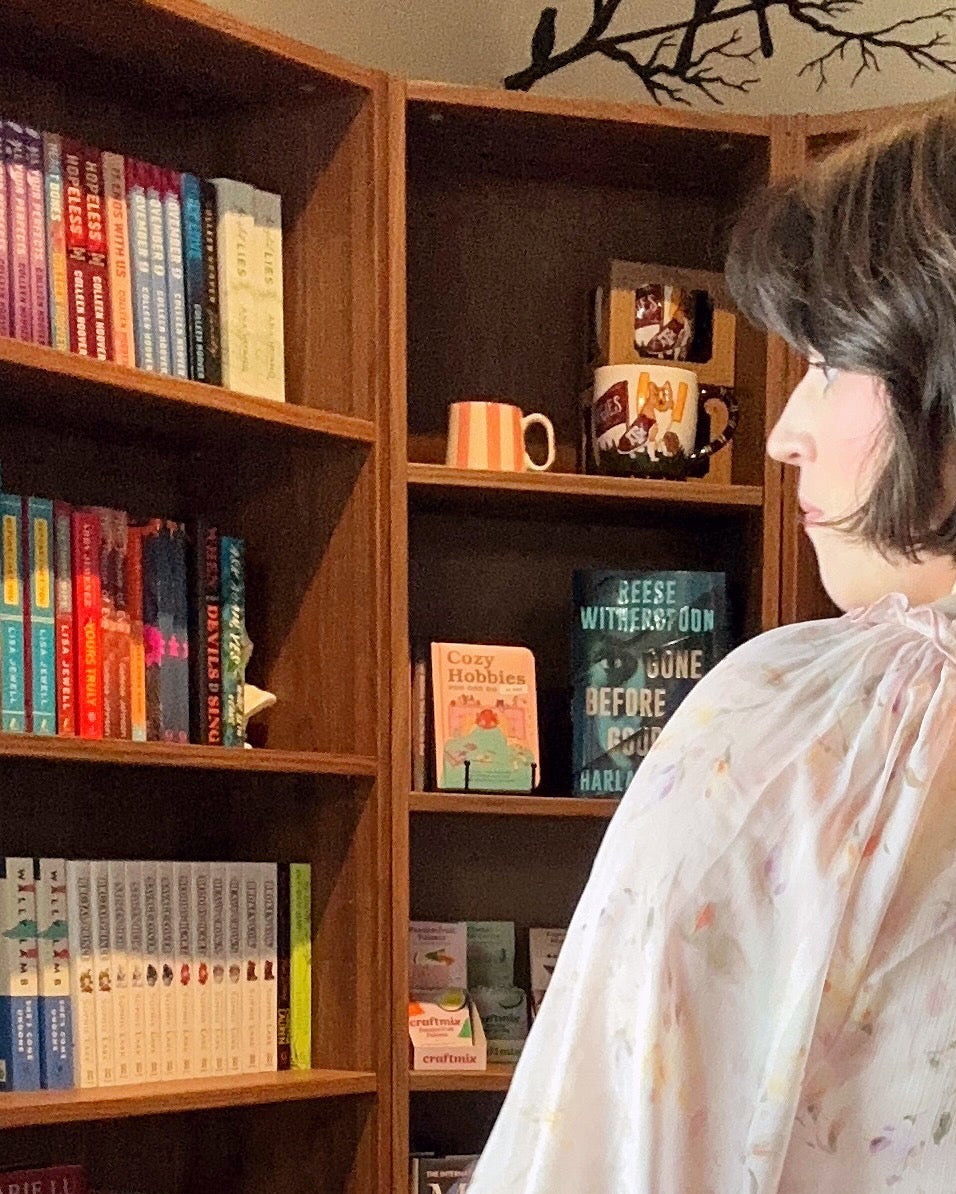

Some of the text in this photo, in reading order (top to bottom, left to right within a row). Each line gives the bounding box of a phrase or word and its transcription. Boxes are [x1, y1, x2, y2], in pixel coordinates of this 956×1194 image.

[50, 182, 61, 222] BONES
[114, 223, 125, 256] WITH
[116, 260, 126, 278] US
[74, 270, 85, 313] COLLEEN
[92, 275, 106, 361] COLLEEN HOOVER
[194, 304, 205, 378] COLLEEN HOOVER
[618, 579, 677, 605] REESE
[580, 605, 715, 633] WITHERSPOON
[206, 605, 219, 679] DEVILS
[447, 650, 495, 666] Cozy
[8, 627, 19, 704] LISA JEWELL
[39, 629, 50, 706] LISA JEWELL
[60, 624, 71, 710] LISA JEWELL
[84, 622, 97, 706] YOURS TRULY
[448, 668, 526, 685] Hobbies
[646, 649, 703, 680] GONE
[207, 695, 220, 743] SING
[585, 688, 666, 717] BEFORE
[19, 939, 28, 986] LAMB
[52, 940, 62, 986] LAMB
[278, 1008, 287, 1044] LAUREN
[410, 1016, 460, 1028] craftmix
[423, 1053, 477, 1064] craftmix
